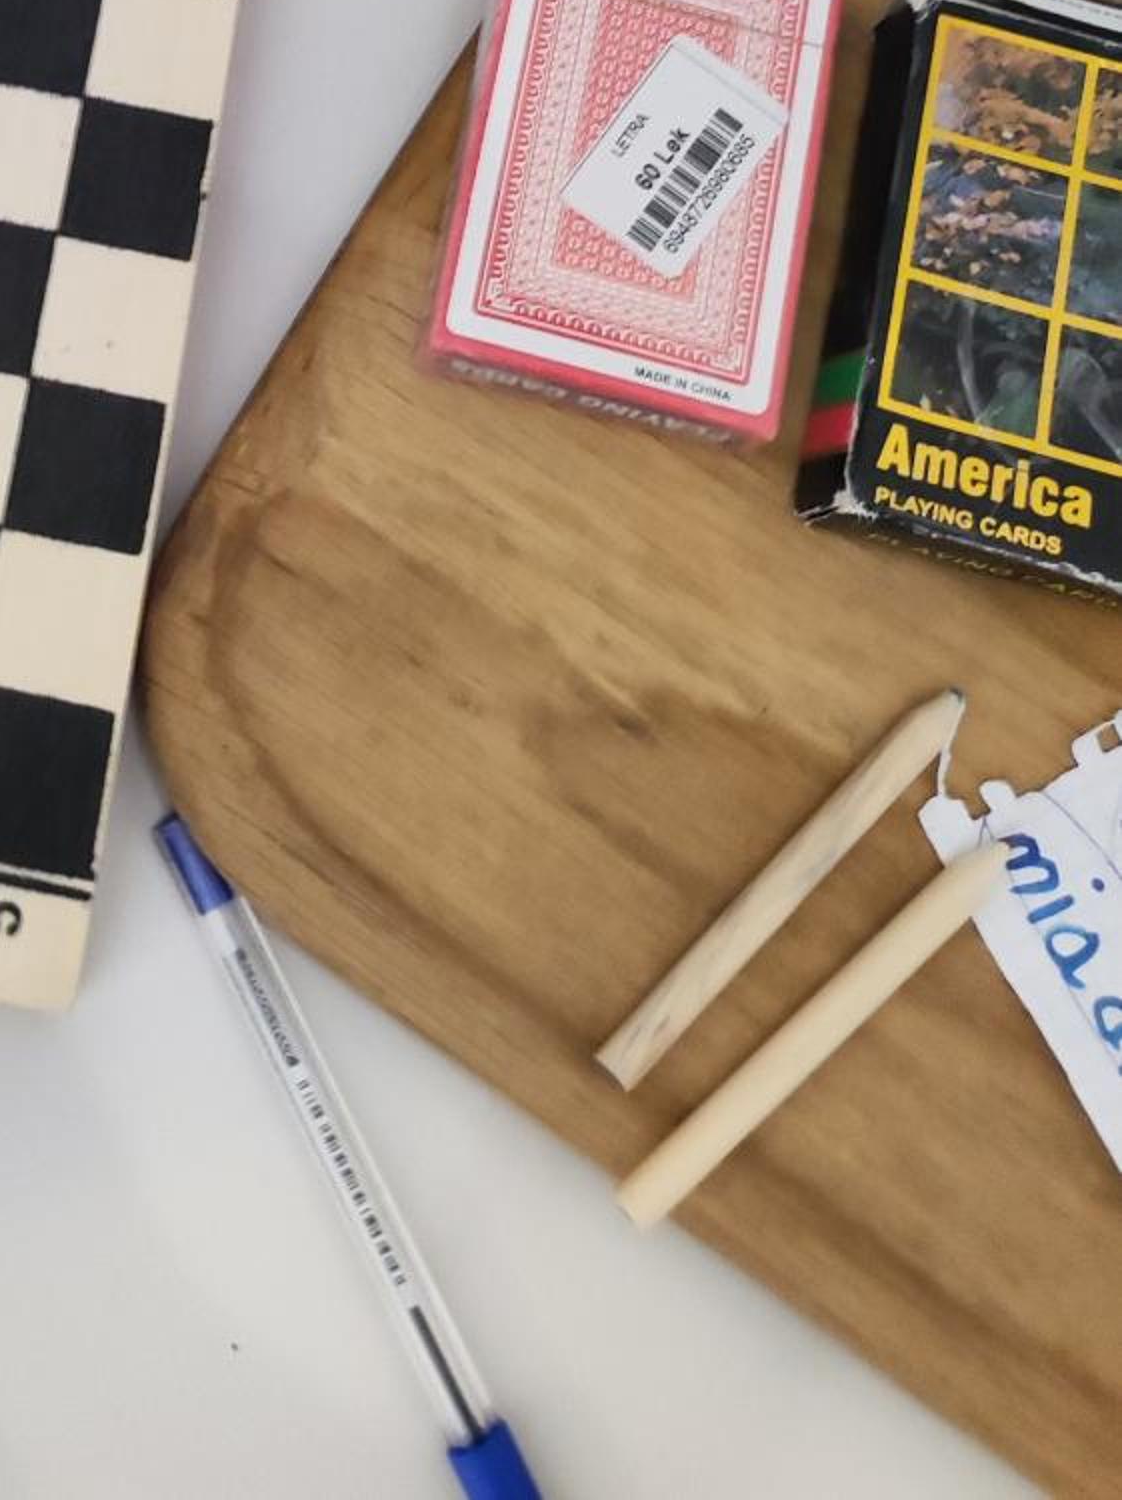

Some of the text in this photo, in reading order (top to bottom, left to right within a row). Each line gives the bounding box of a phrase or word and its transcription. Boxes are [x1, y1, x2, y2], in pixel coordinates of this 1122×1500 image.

[611, 113, 650, 158] LETRA
[635, 128, 690, 190] 60 Lek
[634, 366, 733, 402] MADE IN CHINA
[876, 422, 1094, 529] America
[874, 486, 1062, 556] PLAYING CARDS
